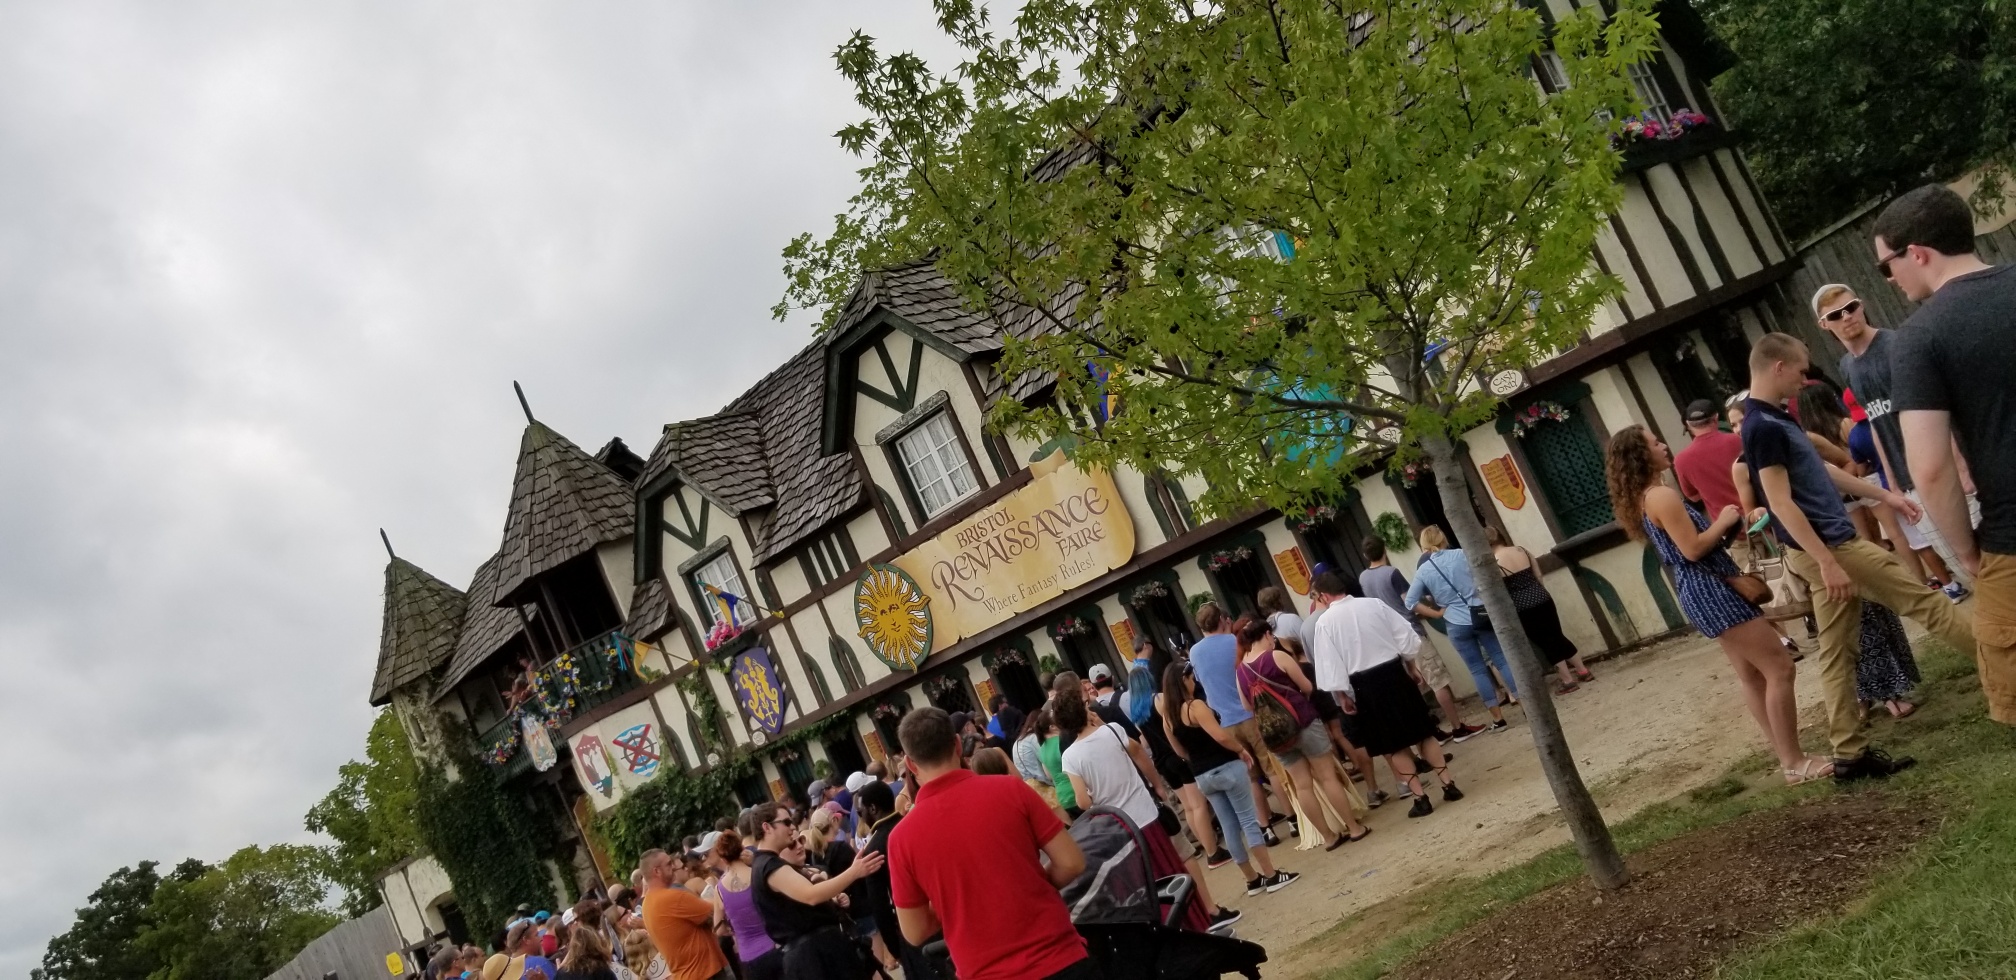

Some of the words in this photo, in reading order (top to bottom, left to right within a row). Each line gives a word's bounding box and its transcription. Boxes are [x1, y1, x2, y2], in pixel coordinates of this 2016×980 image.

[931, 487, 1109, 613] RENAISSANCE
[955, 507, 1015, 549] BRISTOL
[1055, 520, 1106, 561] FAIRE
[982, 593, 1019, 614] Where
[1017, 574, 1058, 600] Fantasy
[1058, 551, 1096, 580] Rules!
